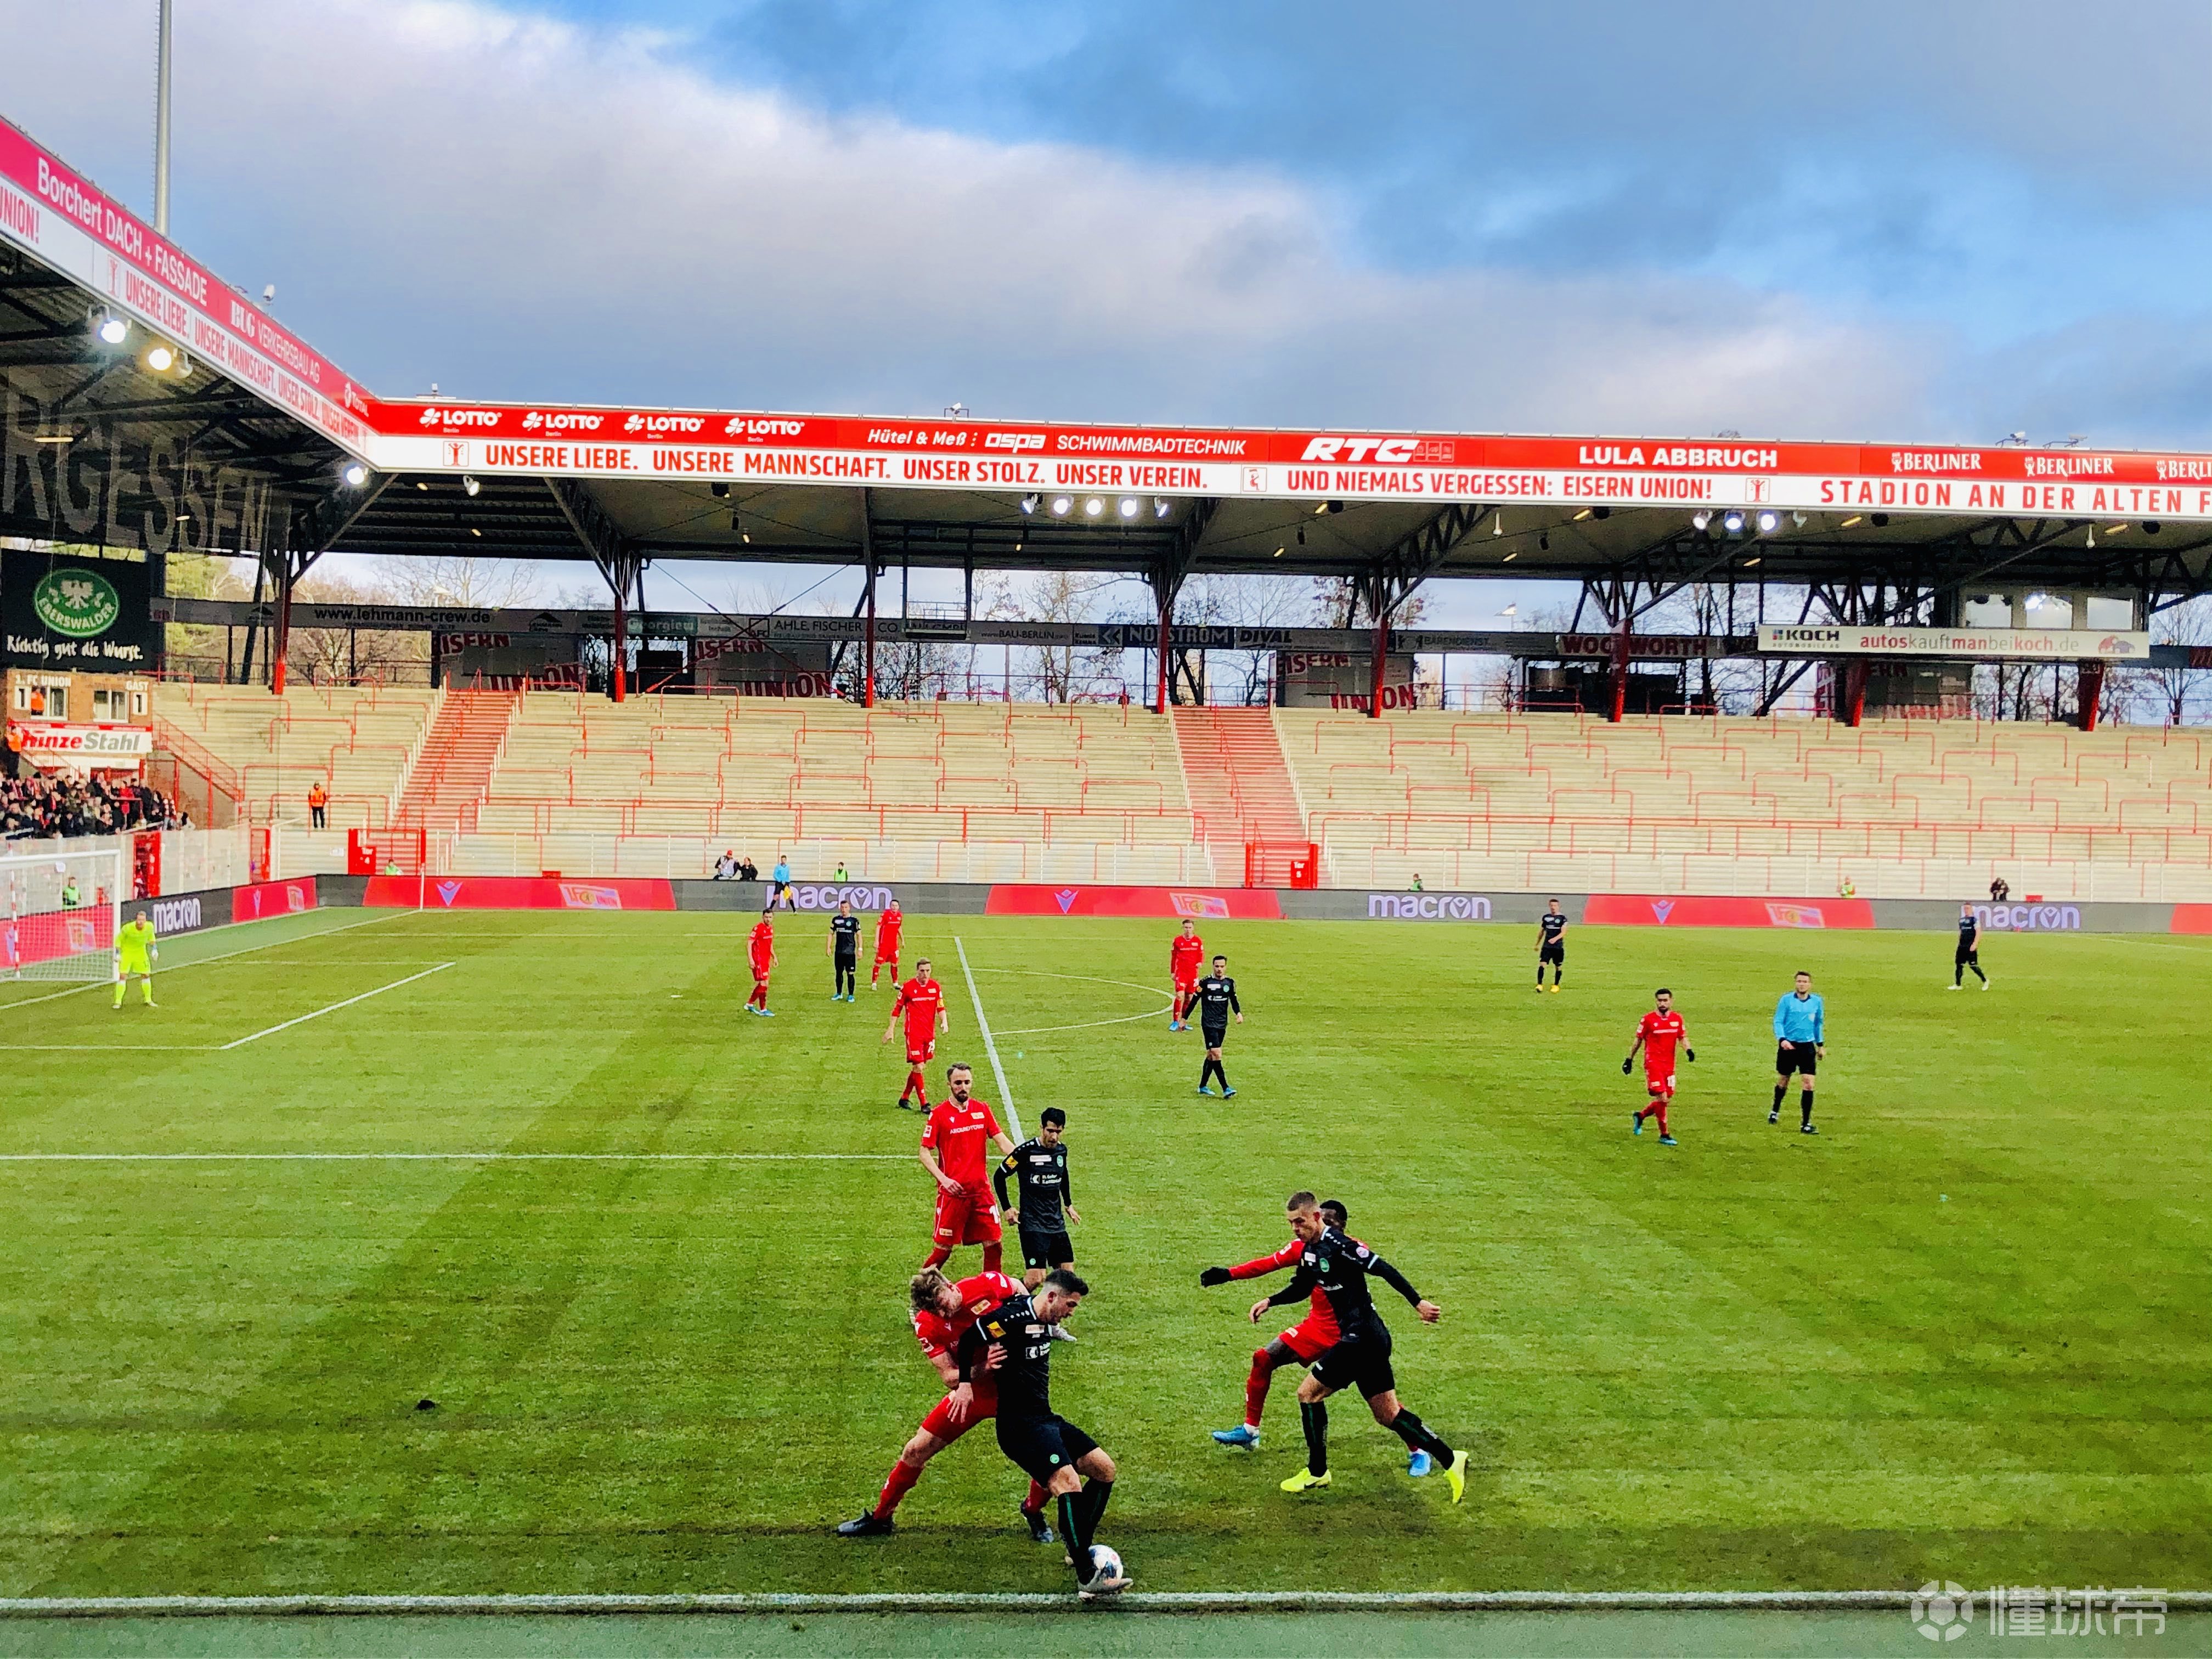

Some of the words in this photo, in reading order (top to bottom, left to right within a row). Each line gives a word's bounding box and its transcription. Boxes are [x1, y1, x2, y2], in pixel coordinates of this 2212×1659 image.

[38, 157, 102, 233] Borchert
[106, 208, 143, 261] DACH
[155, 244, 207, 307] FASSADE
[126, 270, 162, 323] UNSERE
[195, 317, 225, 362] UNSERE
[279, 371, 300, 407] UNSER
[309, 358, 320, 385] AG
[867, 428, 913, 445] Hütel
[916, 432, 928, 445] &
[932, 431, 967, 446] Meß
[985, 432, 1047, 453] ospa
[1057, 435, 1246, 455] SCHWIMMBADTECHNIK
[1300, 437, 1420, 463] RTC
[1579, 446, 1645, 465] LULA
[1652, 448, 1778, 468] ABBRUCH
[486, 444, 568, 468] UNSERE
[574, 447, 638, 470] LIEBE.
[653, 450, 734, 473] UNSERE
[744, 453, 891, 479] MANNSCHAFT.
[904, 458, 970, 482] UNSER
[977, 461, 1045, 484] STOLZ.
[1057, 463, 1122, 486] UNSER
[1129, 465, 1207, 488] VEREIN.
[1904, 453, 1982, 473] BERLINER
[2036, 456, 2115, 478] BERLINER
[1288, 470, 1329, 491] UND
[1336, 471, 1424, 493] NIEMALS
[1430, 473, 1553, 496] VERGESSEN:
[1564, 476, 1634, 498] EISERN
[1640, 477, 1712, 499] UNION!
[1821, 480, 1951, 507] STADION
[1968, 484, 2005, 508] AN
[2023, 486, 2075, 510] DER
[2093, 488, 2182, 512] ALTEN
[38, 597, 115, 630] EBERSWALDER
[314, 607, 490, 623] www.lehmann-crew.de
[813, 620, 862, 632] FISCHER
[1239, 630, 1291, 643] DIVAL
[1786, 629, 1839, 641] KOCH
[7, 635, 49, 659] Richtig
[54, 641, 77, 660] gut
[81, 640, 99, 657] die
[103, 641, 144, 662] Wurst.
[1562, 636, 1707, 656] WOOWORTH
[1860, 634, 2079, 652] autoskauftmanbeikoch.de
[27, 674, 38, 685] FC
[41, 675, 72, 687] UNION
[125, 680, 149, 692] GAST
[84, 732, 140, 751] Stahl
[766, 885, 893, 910] macron
[1369, 894, 1492, 919] macron
[153, 898, 201, 934] macron
[1961, 905, 2080, 929] macron
